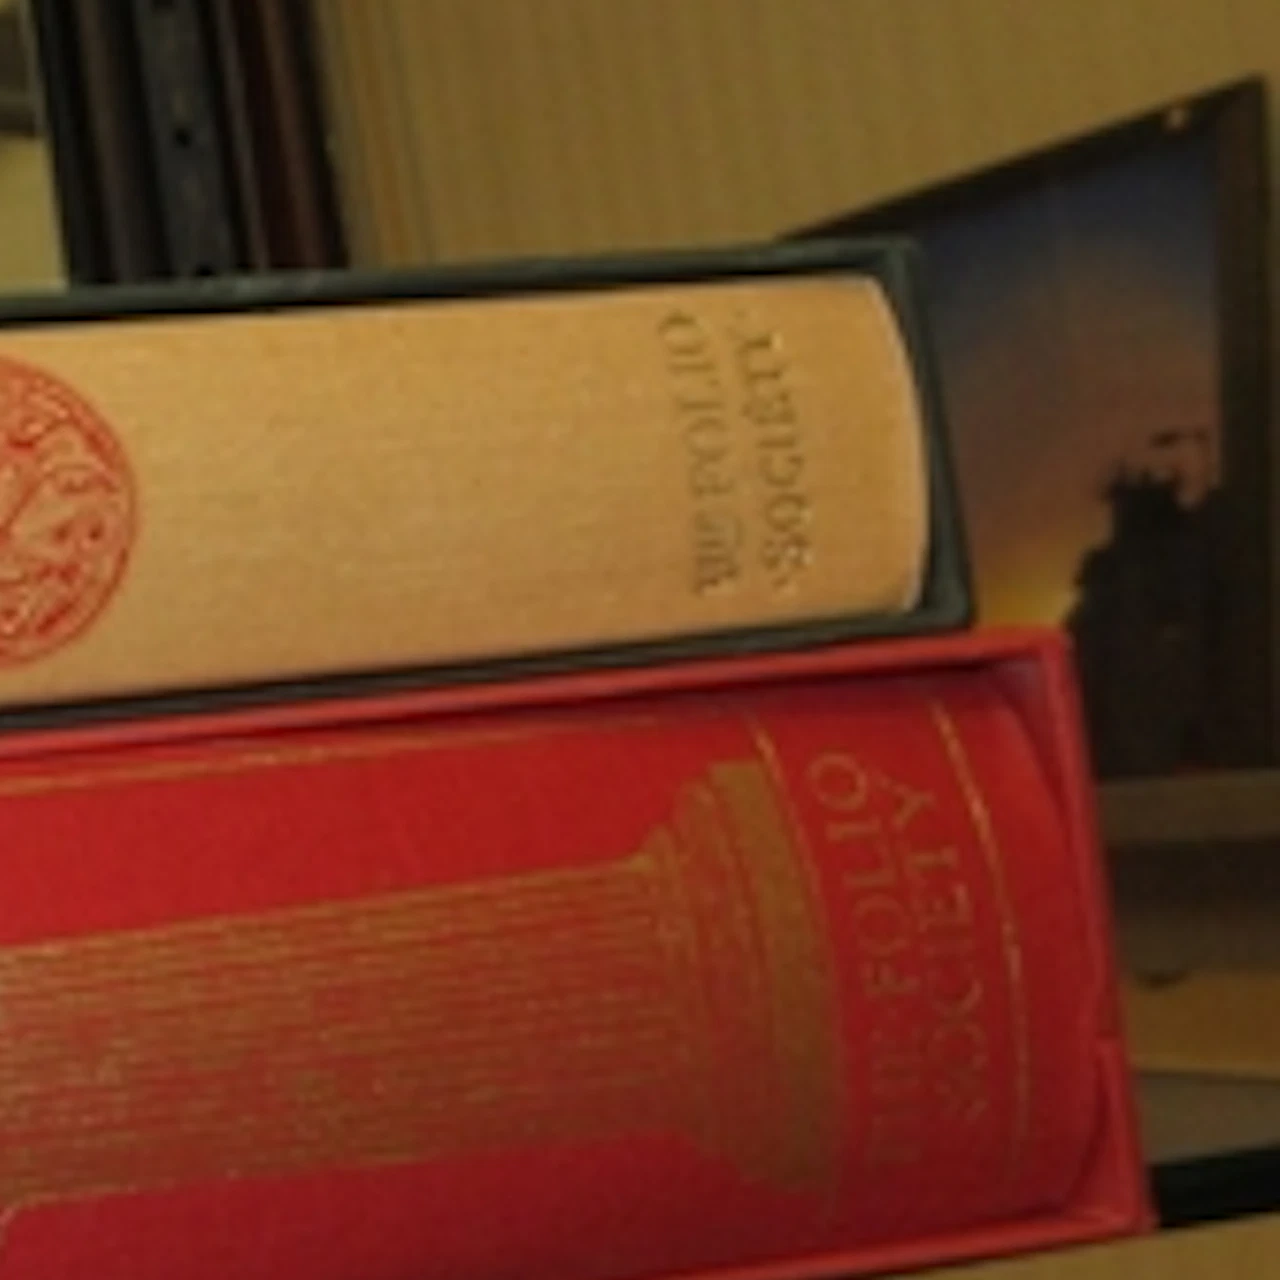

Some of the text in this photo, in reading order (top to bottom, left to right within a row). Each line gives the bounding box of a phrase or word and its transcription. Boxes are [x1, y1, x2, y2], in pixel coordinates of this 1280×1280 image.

[654, 309, 737, 502] FOLIO
[725, 325, 810, 573] SOCIETY
[803, 751, 921, 999] FOLIO
